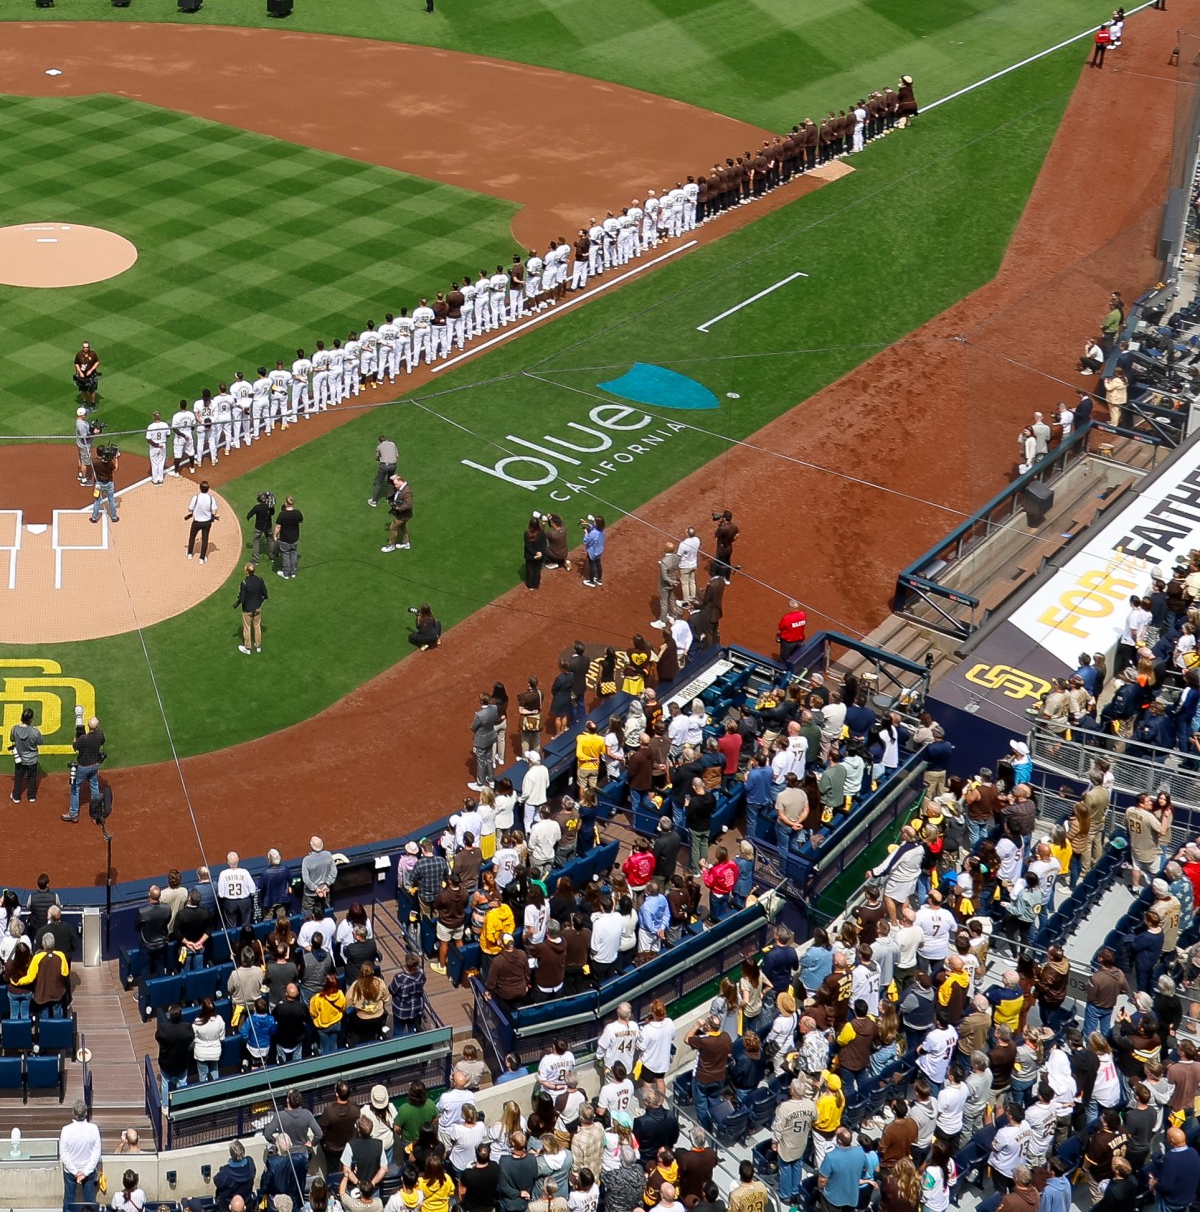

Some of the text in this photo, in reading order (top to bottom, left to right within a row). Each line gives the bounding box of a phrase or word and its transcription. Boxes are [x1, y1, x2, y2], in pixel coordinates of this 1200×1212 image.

[241, 390, 248, 398] 13
[202, 408, 211, 416] 23
[461, 404, 652, 491] blue
[550, 421, 687, 501] CALIFORNIA
[1037, 569, 1138, 639] FOR
[680, 678, 708, 700] PADRES
[1130, 821, 1142, 834] 23
[228, 884, 242, 896] 23
[1170, 915, 1179, 928] 13
[933, 924, 941, 937] 7
[618, 1040, 632, 1053] 44
[617, 1097, 629, 1110] 19
[793, 1120, 807, 1133] 51
[1019, 1141, 1029, 1157] 13
[584, 1202, 597, 1212] 23
